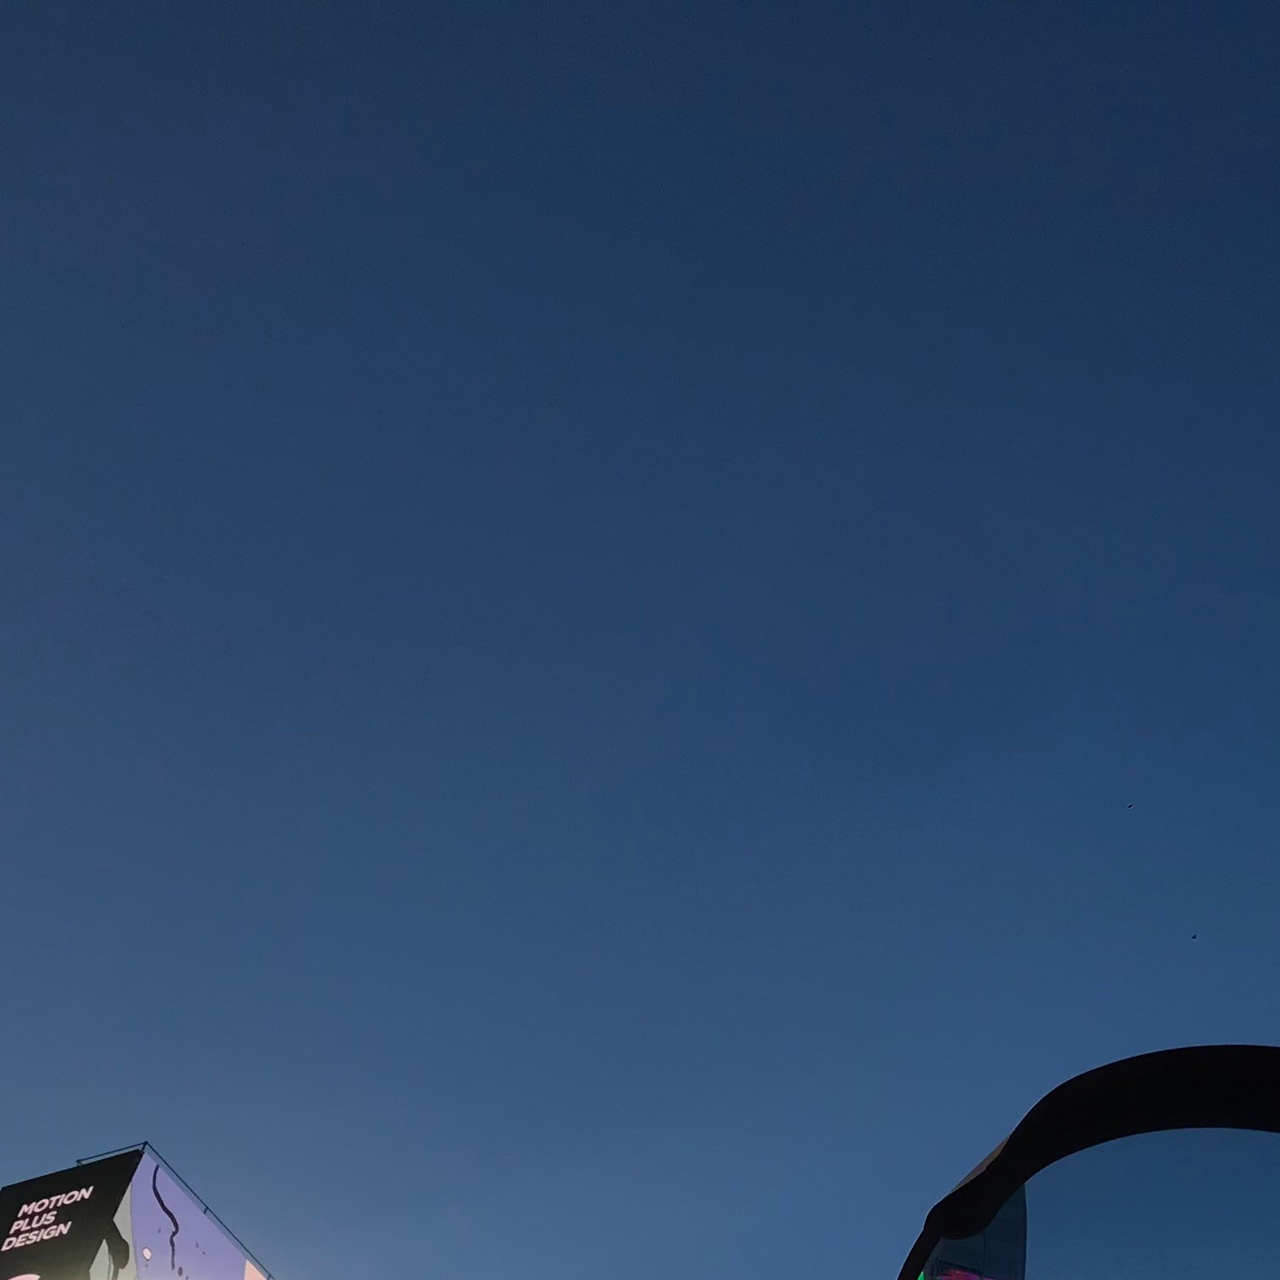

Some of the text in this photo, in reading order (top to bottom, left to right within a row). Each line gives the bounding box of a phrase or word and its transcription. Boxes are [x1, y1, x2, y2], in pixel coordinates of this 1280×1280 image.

[17, 1185, 94, 1218] MOTION
[0, 1220, 73, 1252] DESIGN
[9, 1210, 58, 1235] PLUS
